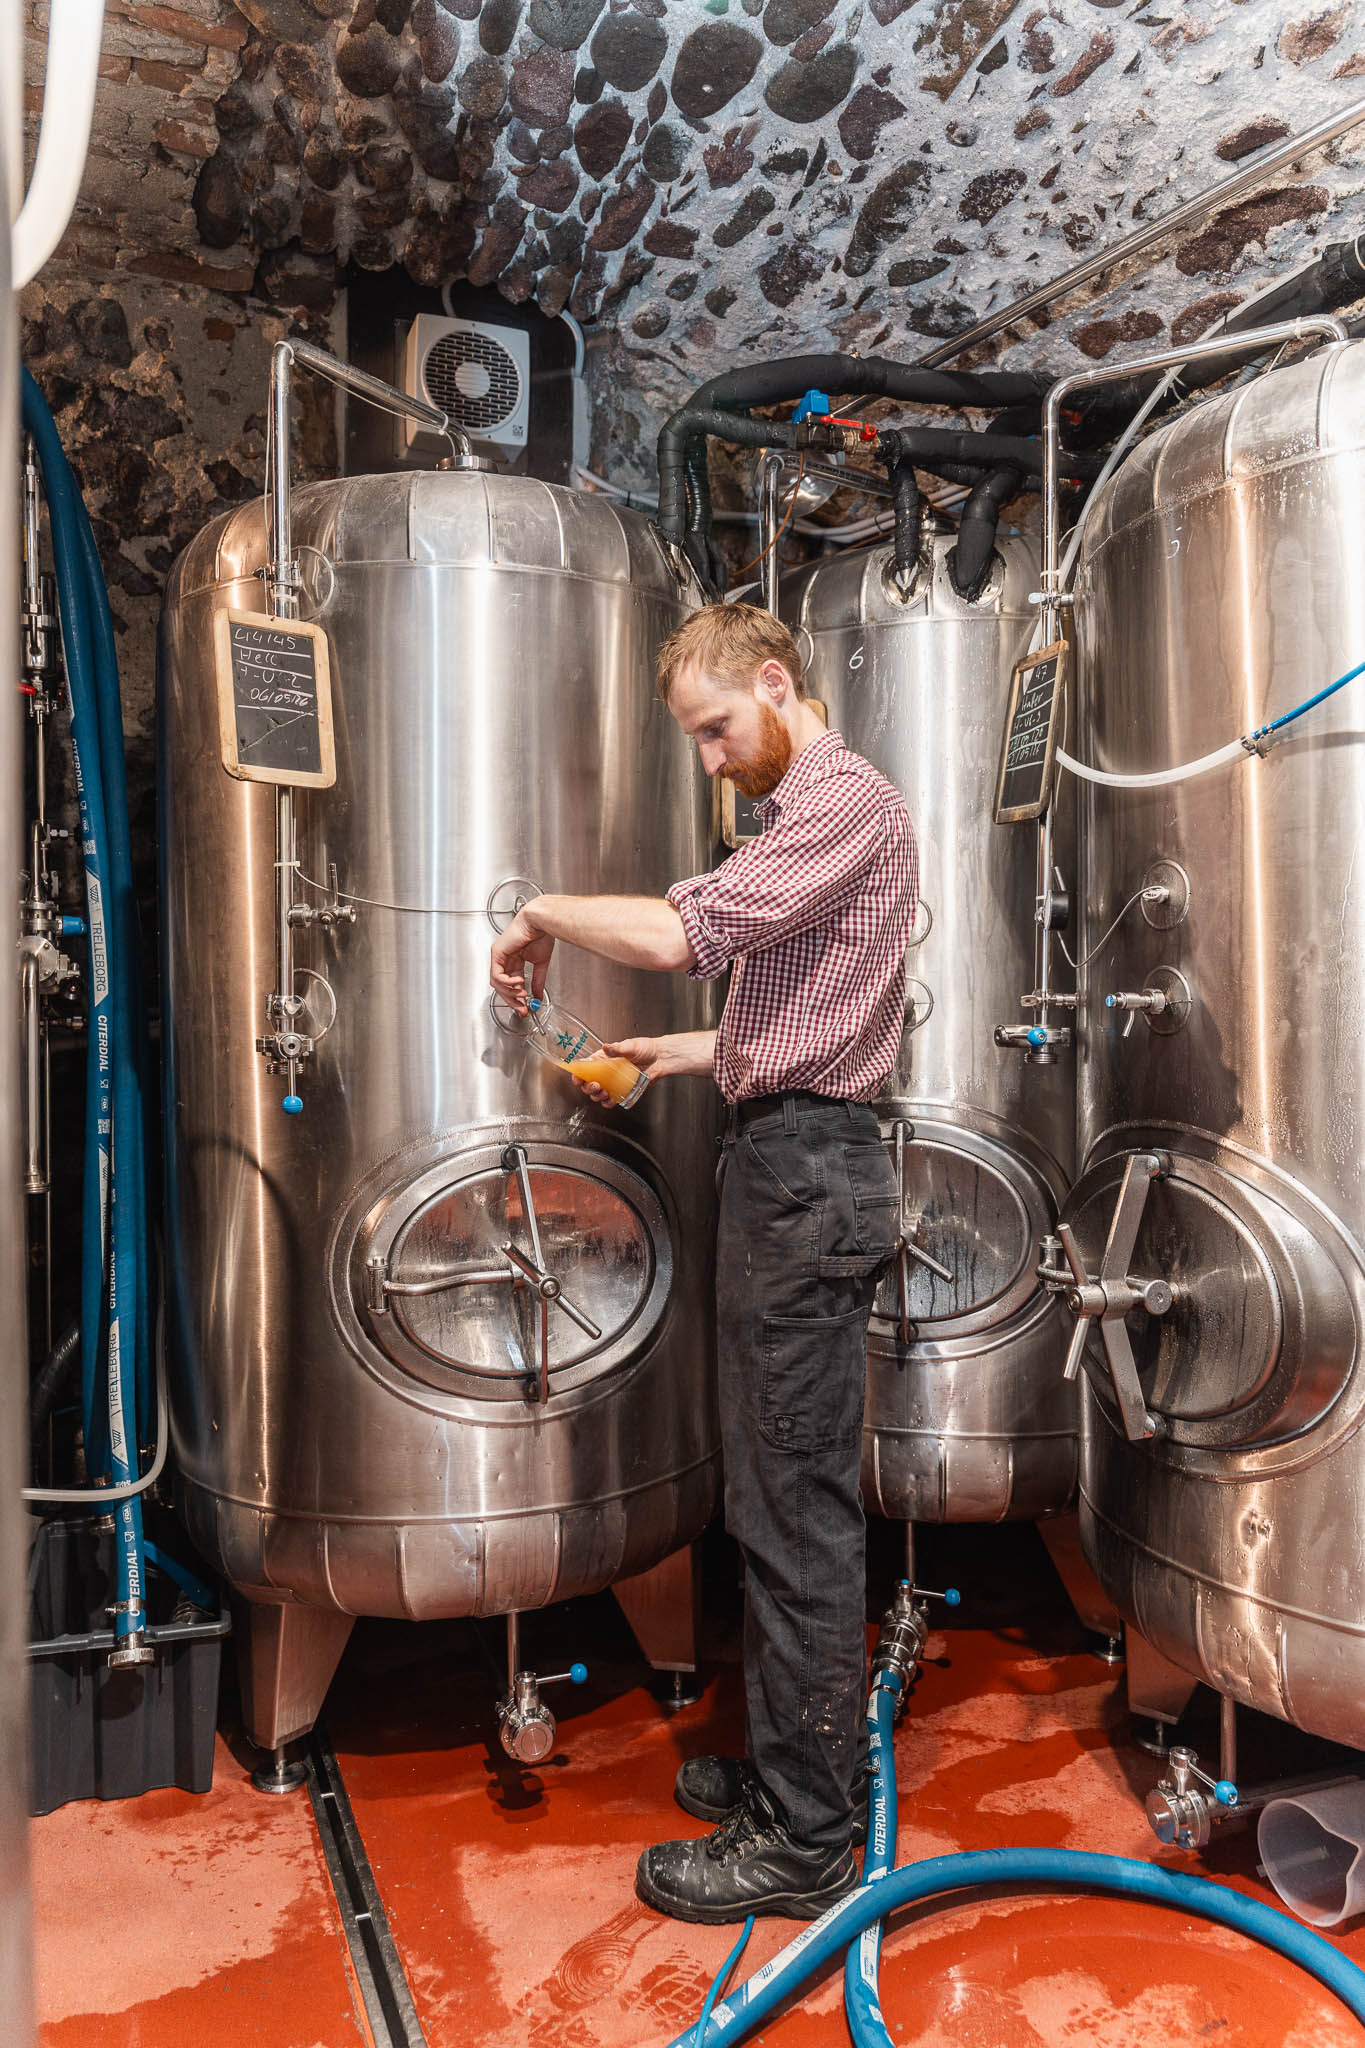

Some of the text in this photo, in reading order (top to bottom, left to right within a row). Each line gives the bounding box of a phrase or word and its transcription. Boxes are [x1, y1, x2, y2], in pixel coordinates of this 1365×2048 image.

[849, 646, 864, 670] 6
[92, 920, 106, 992] TRELLEBORG
[97, 1015, 109, 1072] CITERDIAL
[127, 1549, 141, 1617] CTERDIAL
[874, 1795, 886, 1856] CITERDIAL
